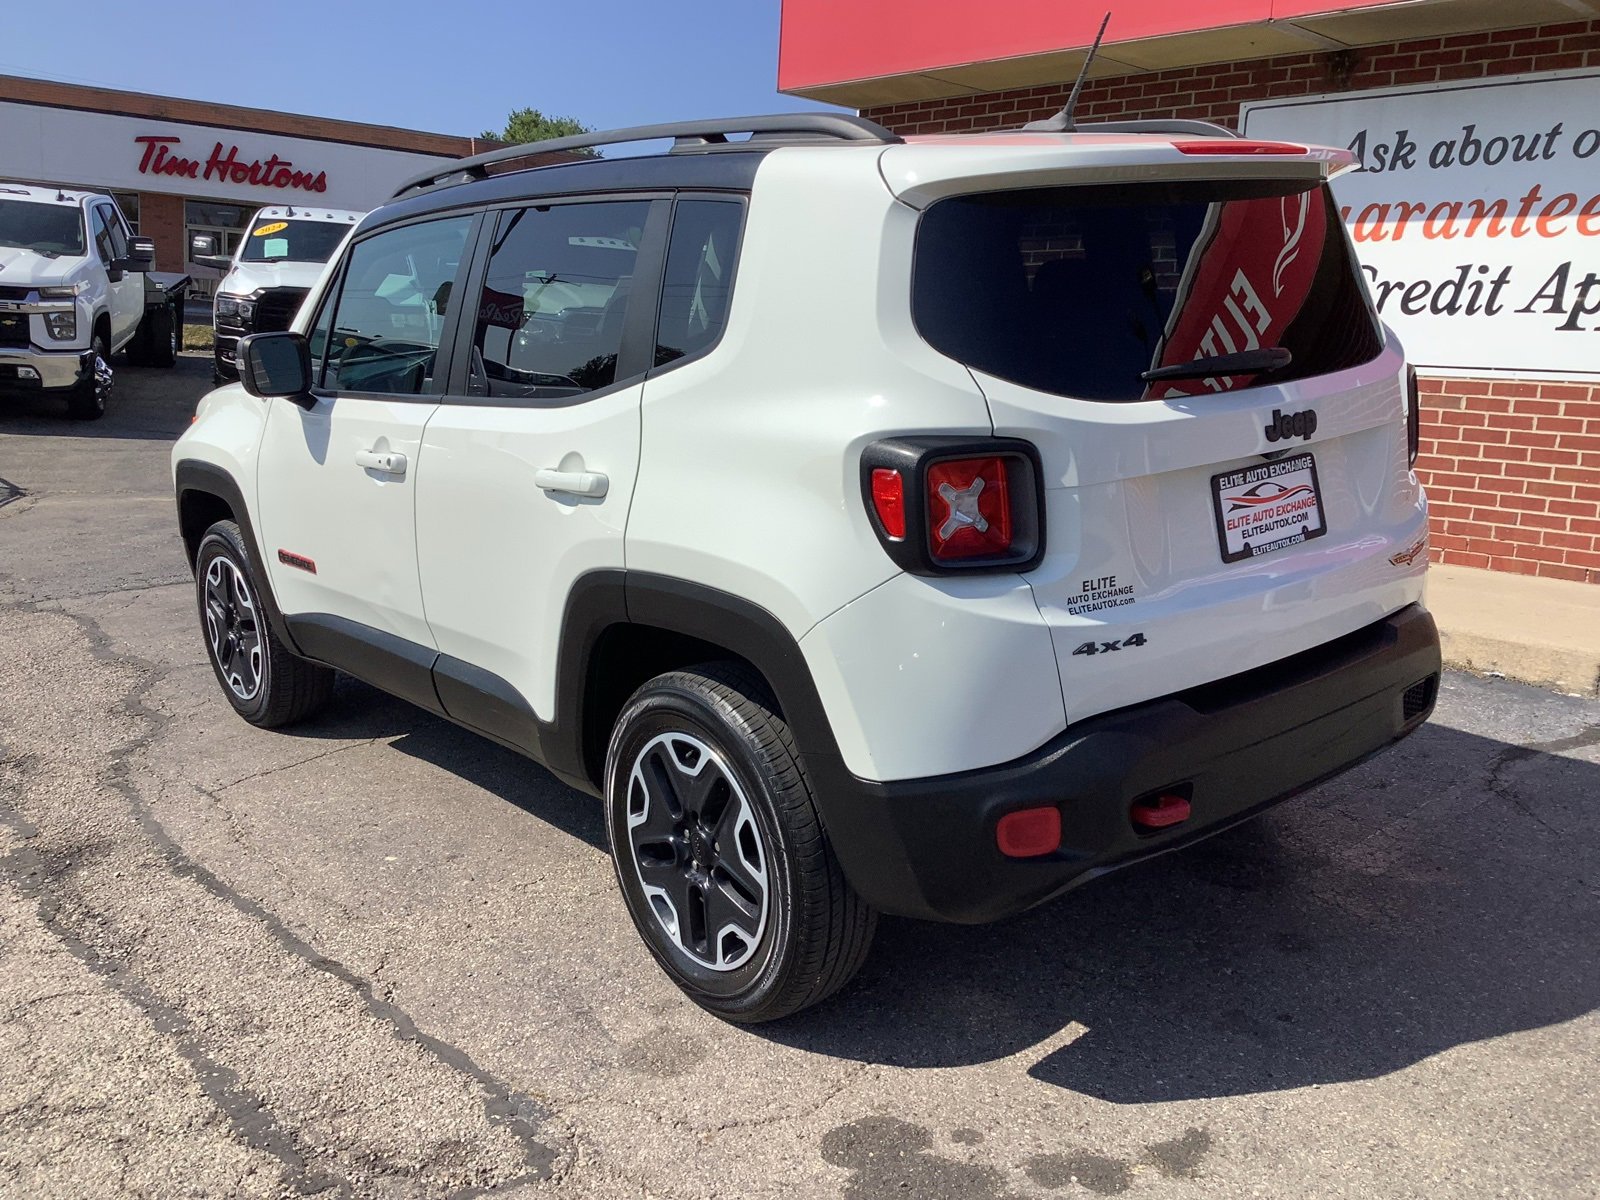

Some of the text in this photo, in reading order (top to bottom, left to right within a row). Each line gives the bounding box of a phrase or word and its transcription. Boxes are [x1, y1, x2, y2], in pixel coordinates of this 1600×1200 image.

[1347, 129, 1416, 173] Ask
[1429, 122, 1563, 169] about
[135, 136, 326, 192] Tim Hortons
[1514, 261, 1600, 331] Ap
[1265, 409, 1317, 442] Jeep
[1219, 456, 1313, 490] ELITE AUTO EXCHANGE
[1226, 495, 1317, 531] ELITE AUTO EXCHANGE
[1241, 511, 1309, 540] ELITEAUTOX.COM
[1252, 533, 1306, 557] ELITEAUTOX.COM
[1066, 584, 1134, 606] AUTO EXCHANGE
[1082, 575, 1116, 593] ELITE
[1068, 597, 1136, 616] ELITEAUTOX.com
[1072, 632, 1147, 656] 4x4
